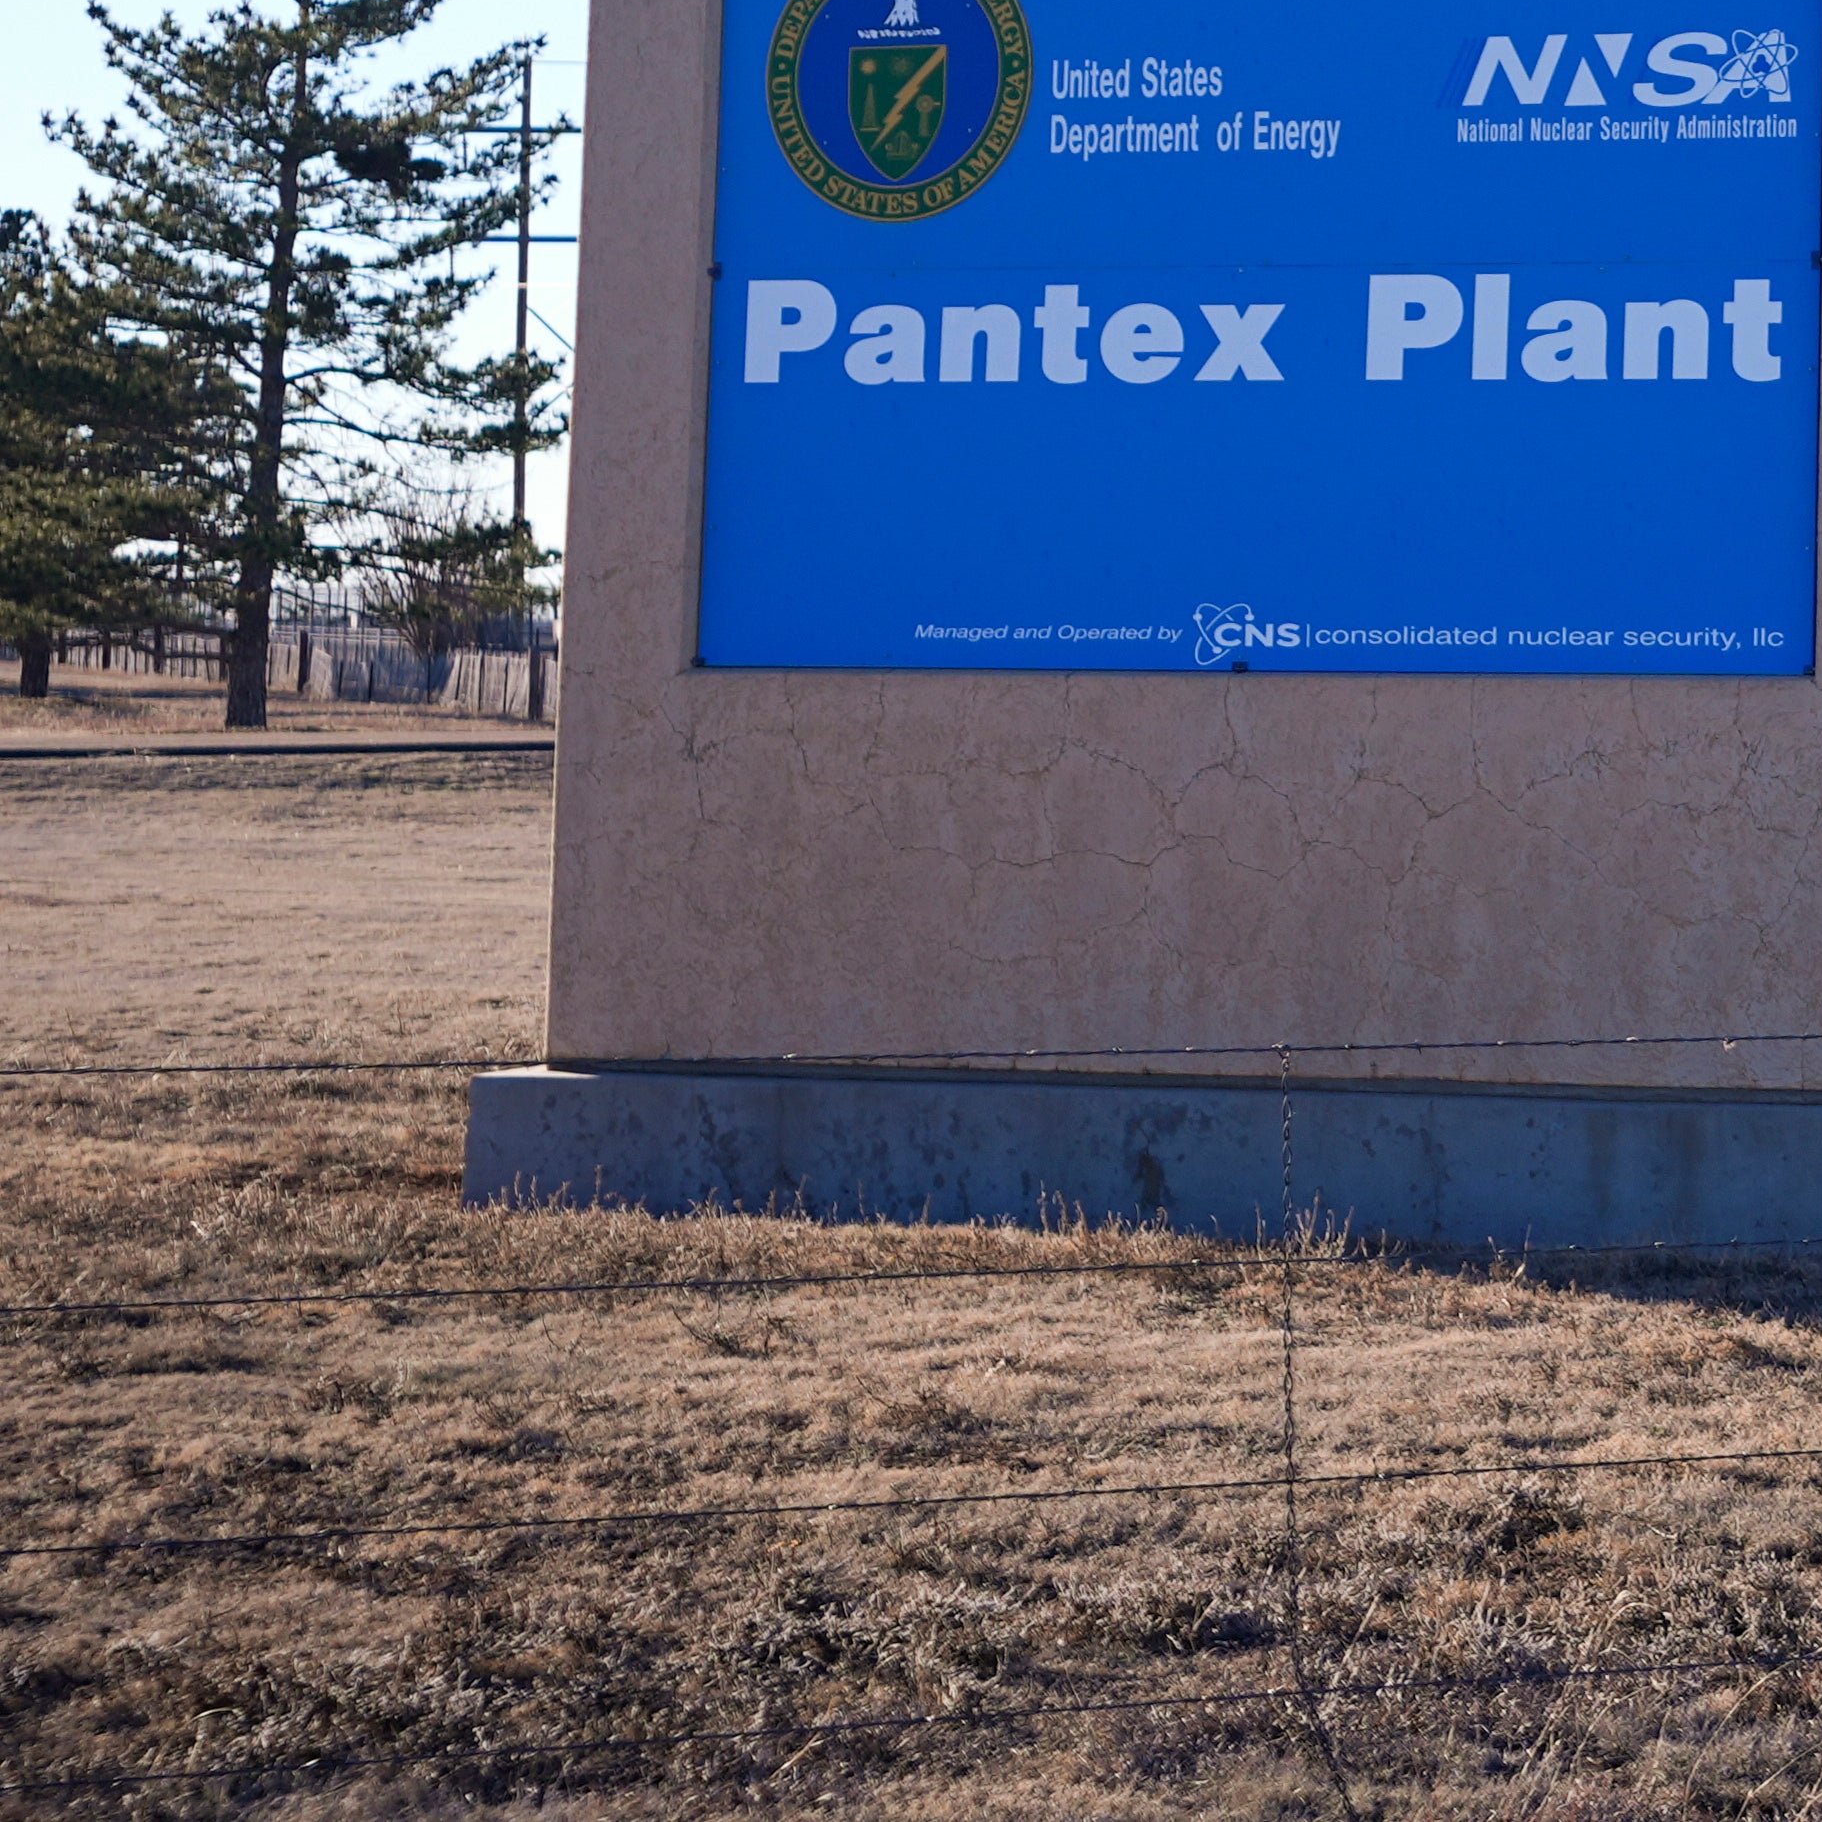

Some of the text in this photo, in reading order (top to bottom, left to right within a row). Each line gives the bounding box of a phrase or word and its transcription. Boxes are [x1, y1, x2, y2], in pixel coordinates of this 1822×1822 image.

[1053, 57, 1222, 99] United States
[1463, 29, 1798, 107] NNSA
[772, 69, 1025, 214] UNITED STATES OF AMERICA
[1051, 111, 1340, 161] Department of Energy
[1458, 114, 1796, 142] National Nuclear Security Administration
[744, 274, 1782, 384] Pantex Plant
[915, 622, 1784, 651] Managed and Operated by CNS consolidated nuclear security, llc
